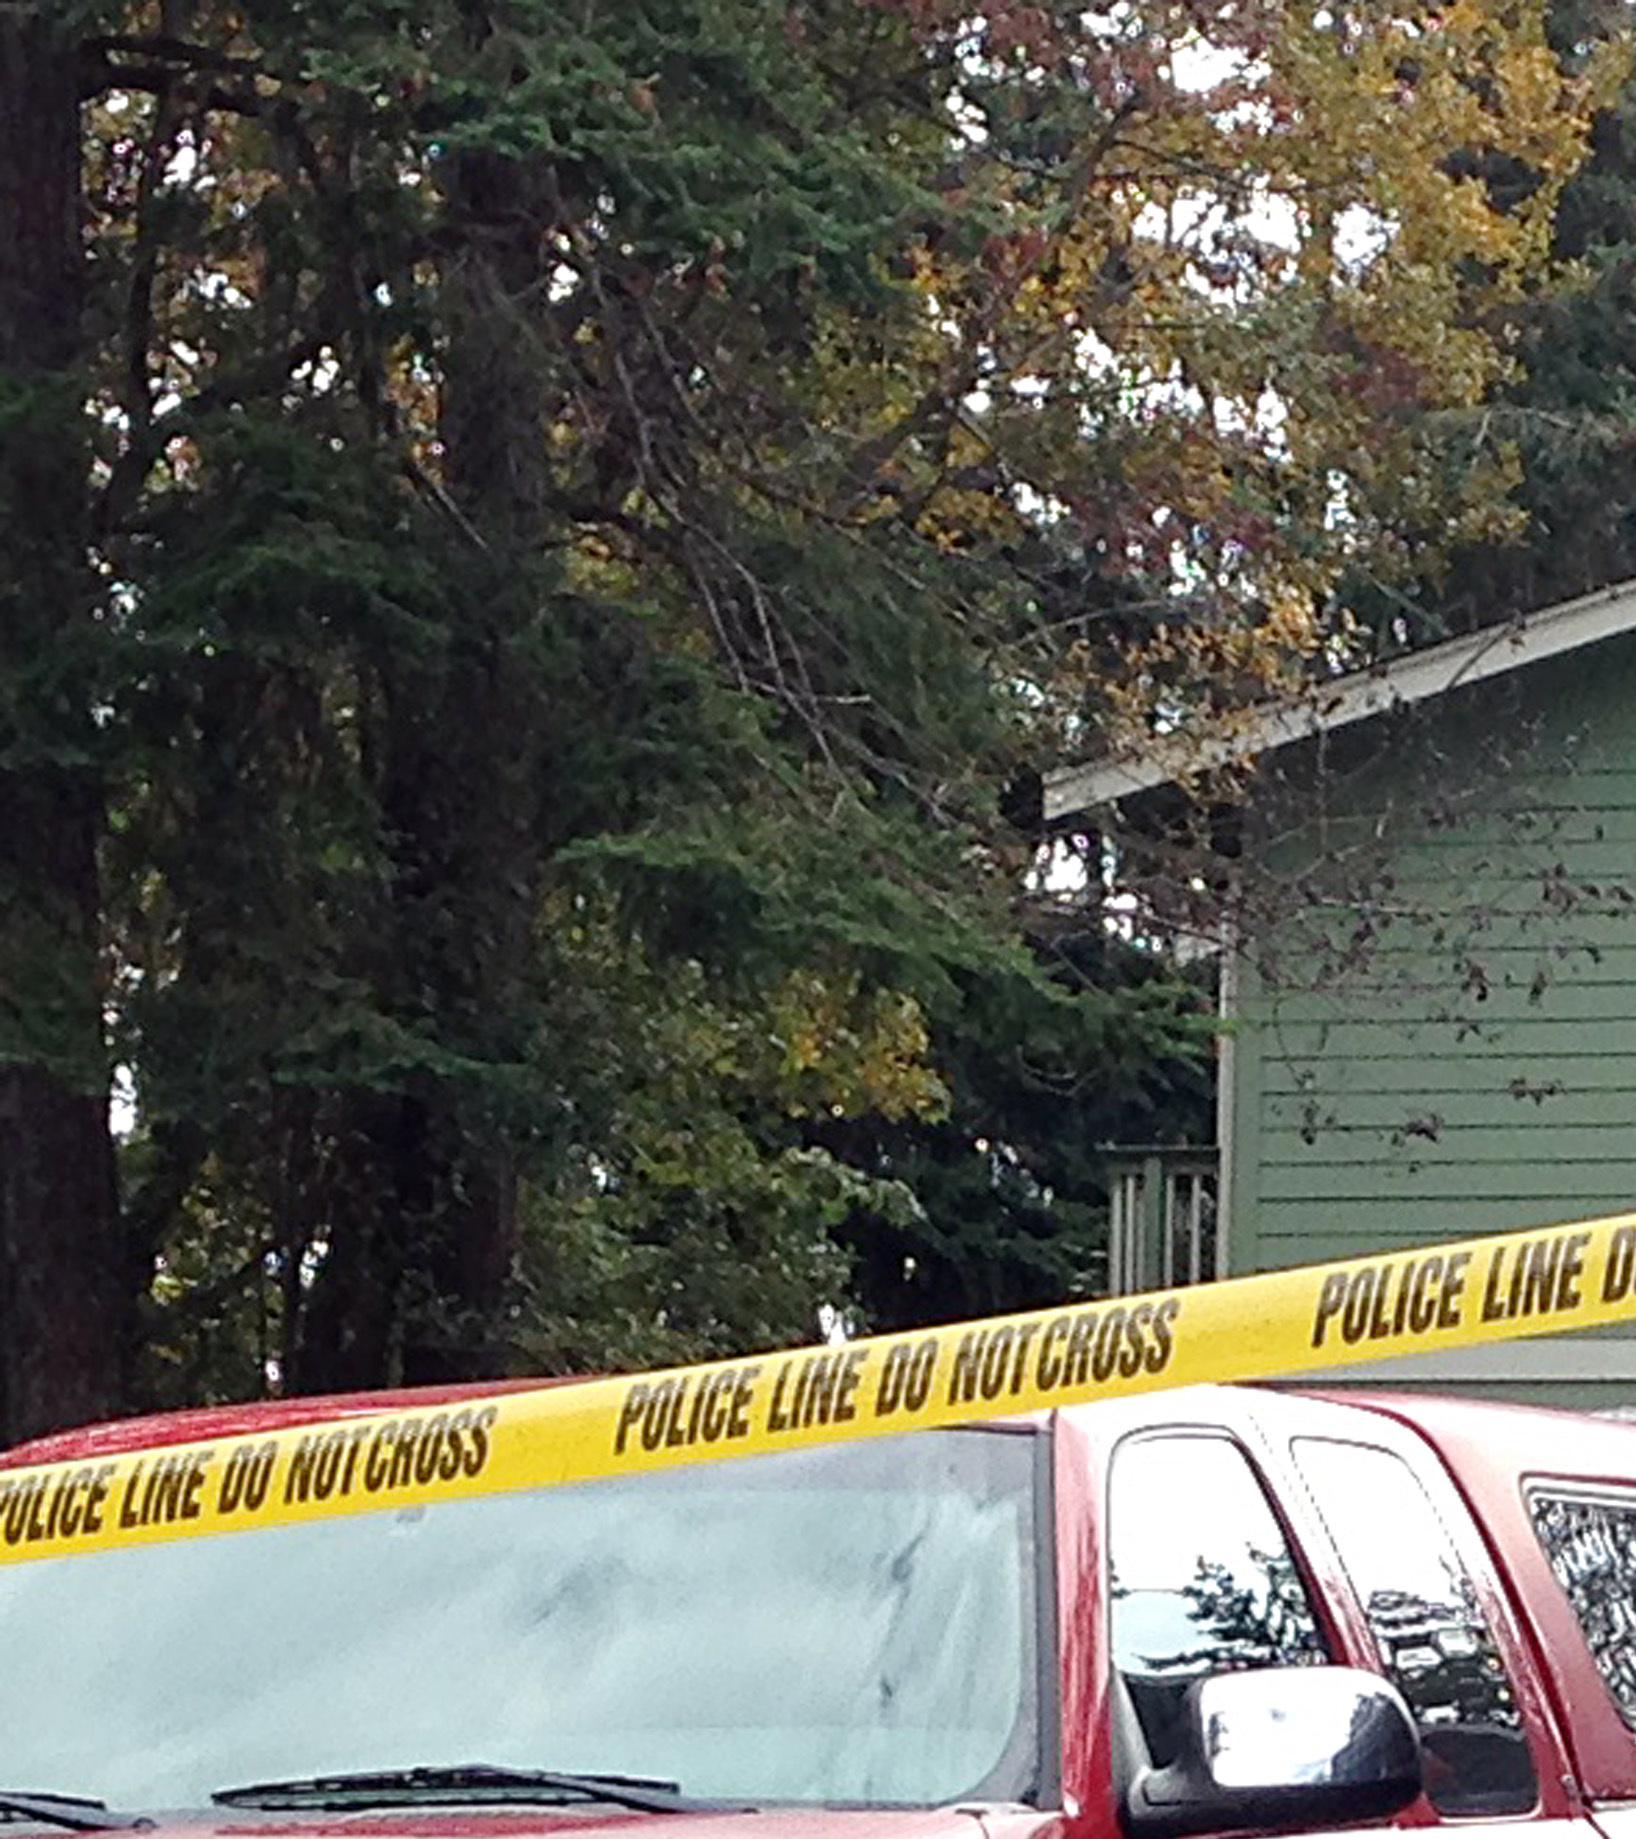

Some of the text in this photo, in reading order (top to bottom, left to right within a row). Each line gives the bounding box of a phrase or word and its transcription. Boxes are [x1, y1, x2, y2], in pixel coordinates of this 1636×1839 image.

[1312, 1252, 1471, 1348] POLICE
[1481, 1231, 1592, 1323] LINE
[614, 1298, 1181, 1455] POLICE LINE DO NOT CROSS
[120, 1450, 213, 1529] LINE
[216, 1441, 277, 1514] DO
[283, 1427, 373, 1503] NOT
[365, 1406, 498, 1493] CROSS
